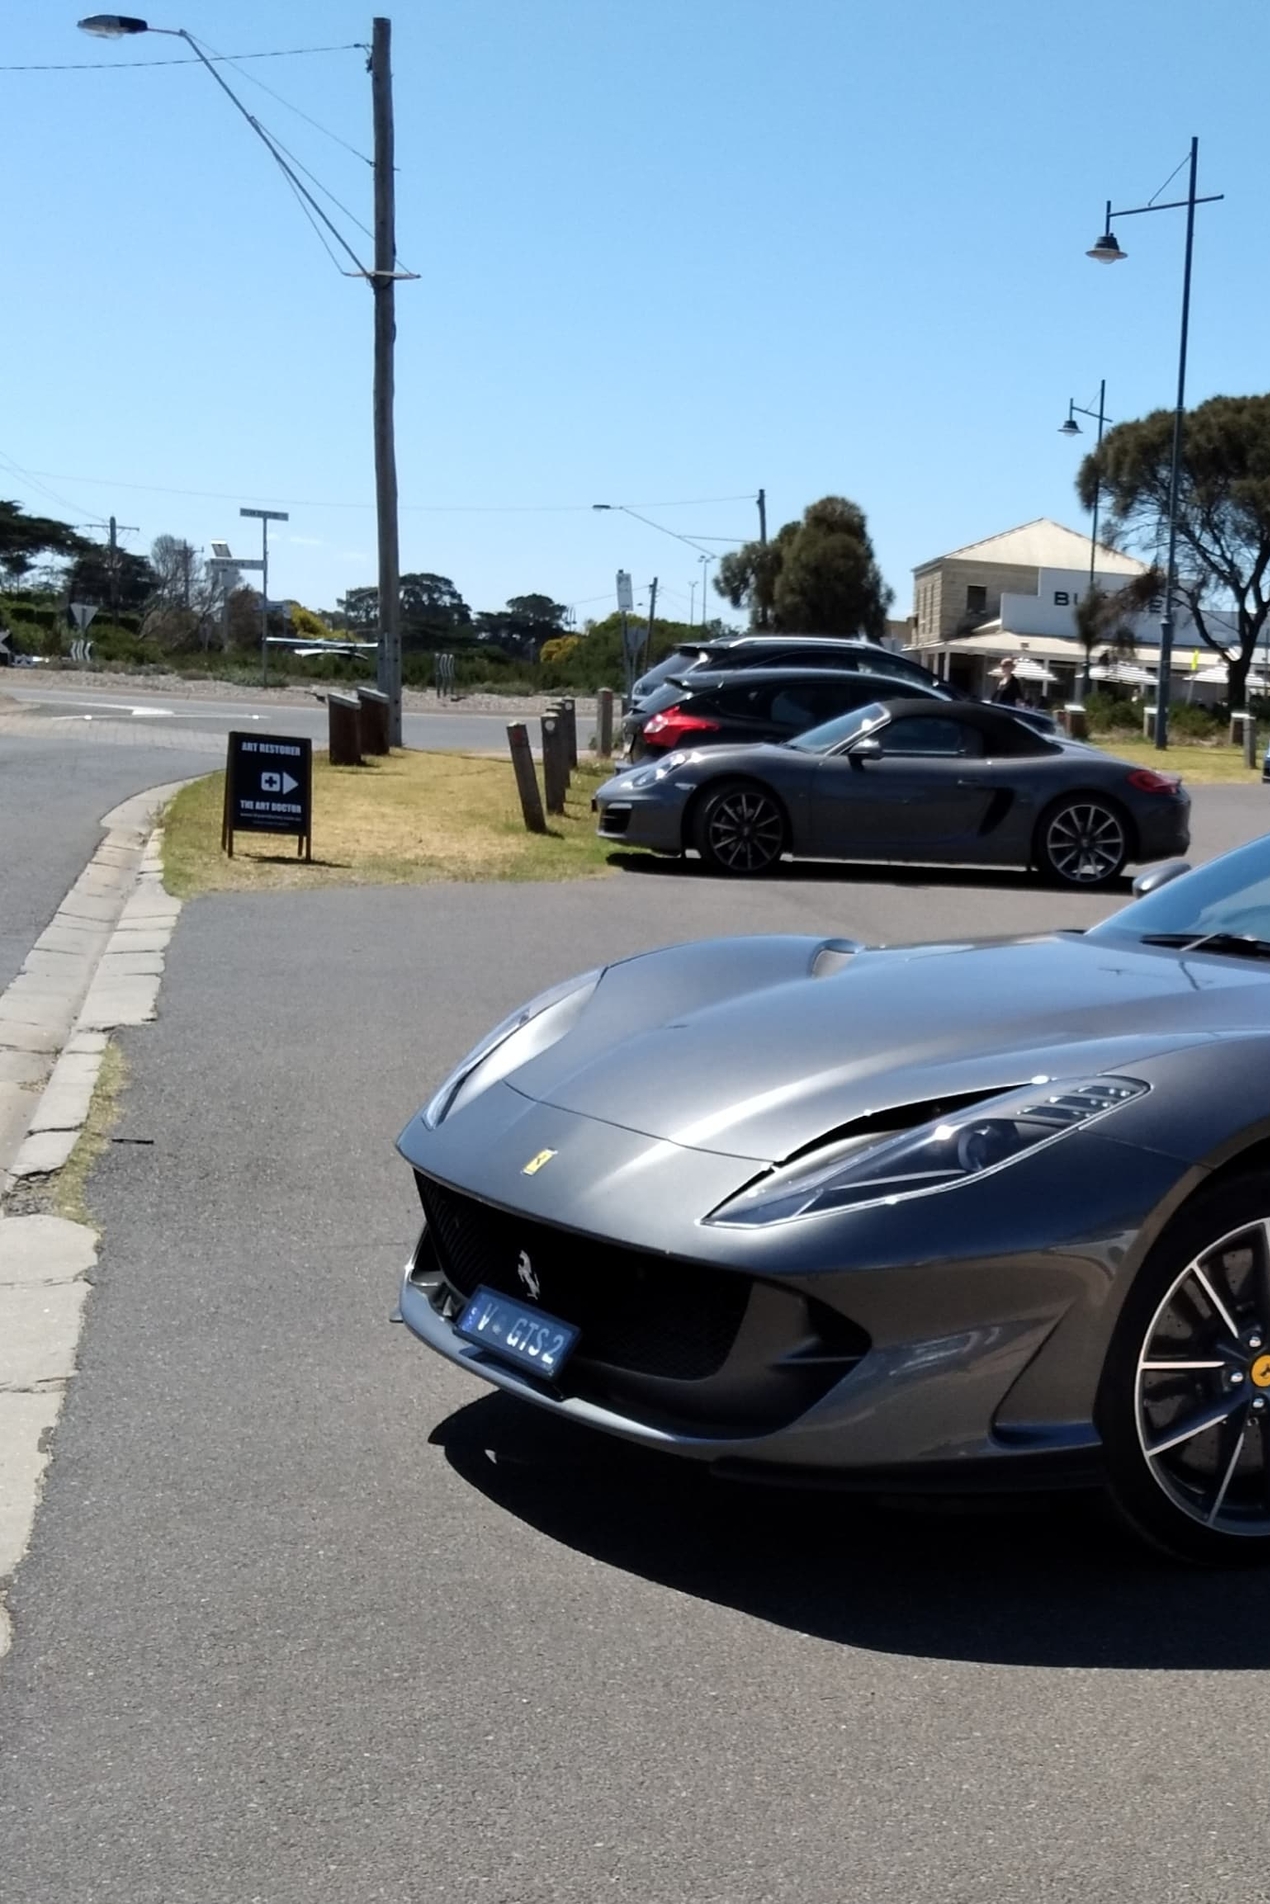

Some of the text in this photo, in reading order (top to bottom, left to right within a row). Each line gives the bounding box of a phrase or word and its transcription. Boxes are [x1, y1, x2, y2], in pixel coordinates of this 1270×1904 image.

[242, 742, 301, 756] ART RESTORER
[240, 800, 301, 813] THE ART DOCTOR
[506, 1318, 565, 1365] GTS2
